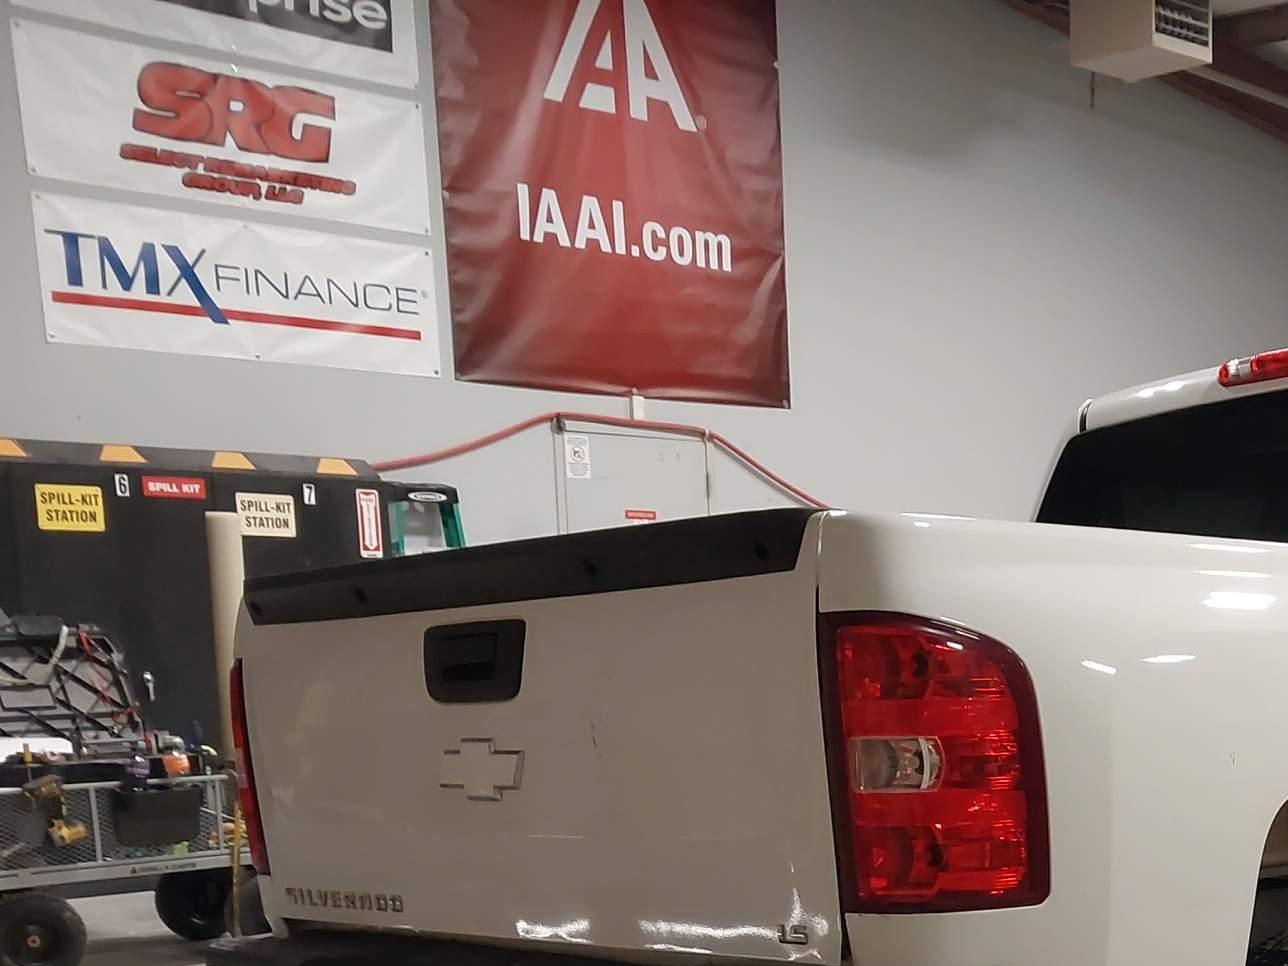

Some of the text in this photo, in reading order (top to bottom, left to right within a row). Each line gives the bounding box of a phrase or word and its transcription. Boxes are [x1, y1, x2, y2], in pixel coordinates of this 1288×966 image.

[132, 61, 336, 163] SRG
[516, 182, 732, 272] IAAI.com
[43, 228, 421, 325] TMX FINANCE
[117, 475, 128, 495] 6
[147, 481, 201, 494] SPILL KIT
[305, 485, 313, 503] 7
[40, 491, 101, 507] SPILL-KIT
[239, 499, 292, 515] SPILL-KIT
[46, 508, 98, 524] STATION
[245, 516, 290, 530] STATION
[285, 887, 405, 913] SILVERADO
